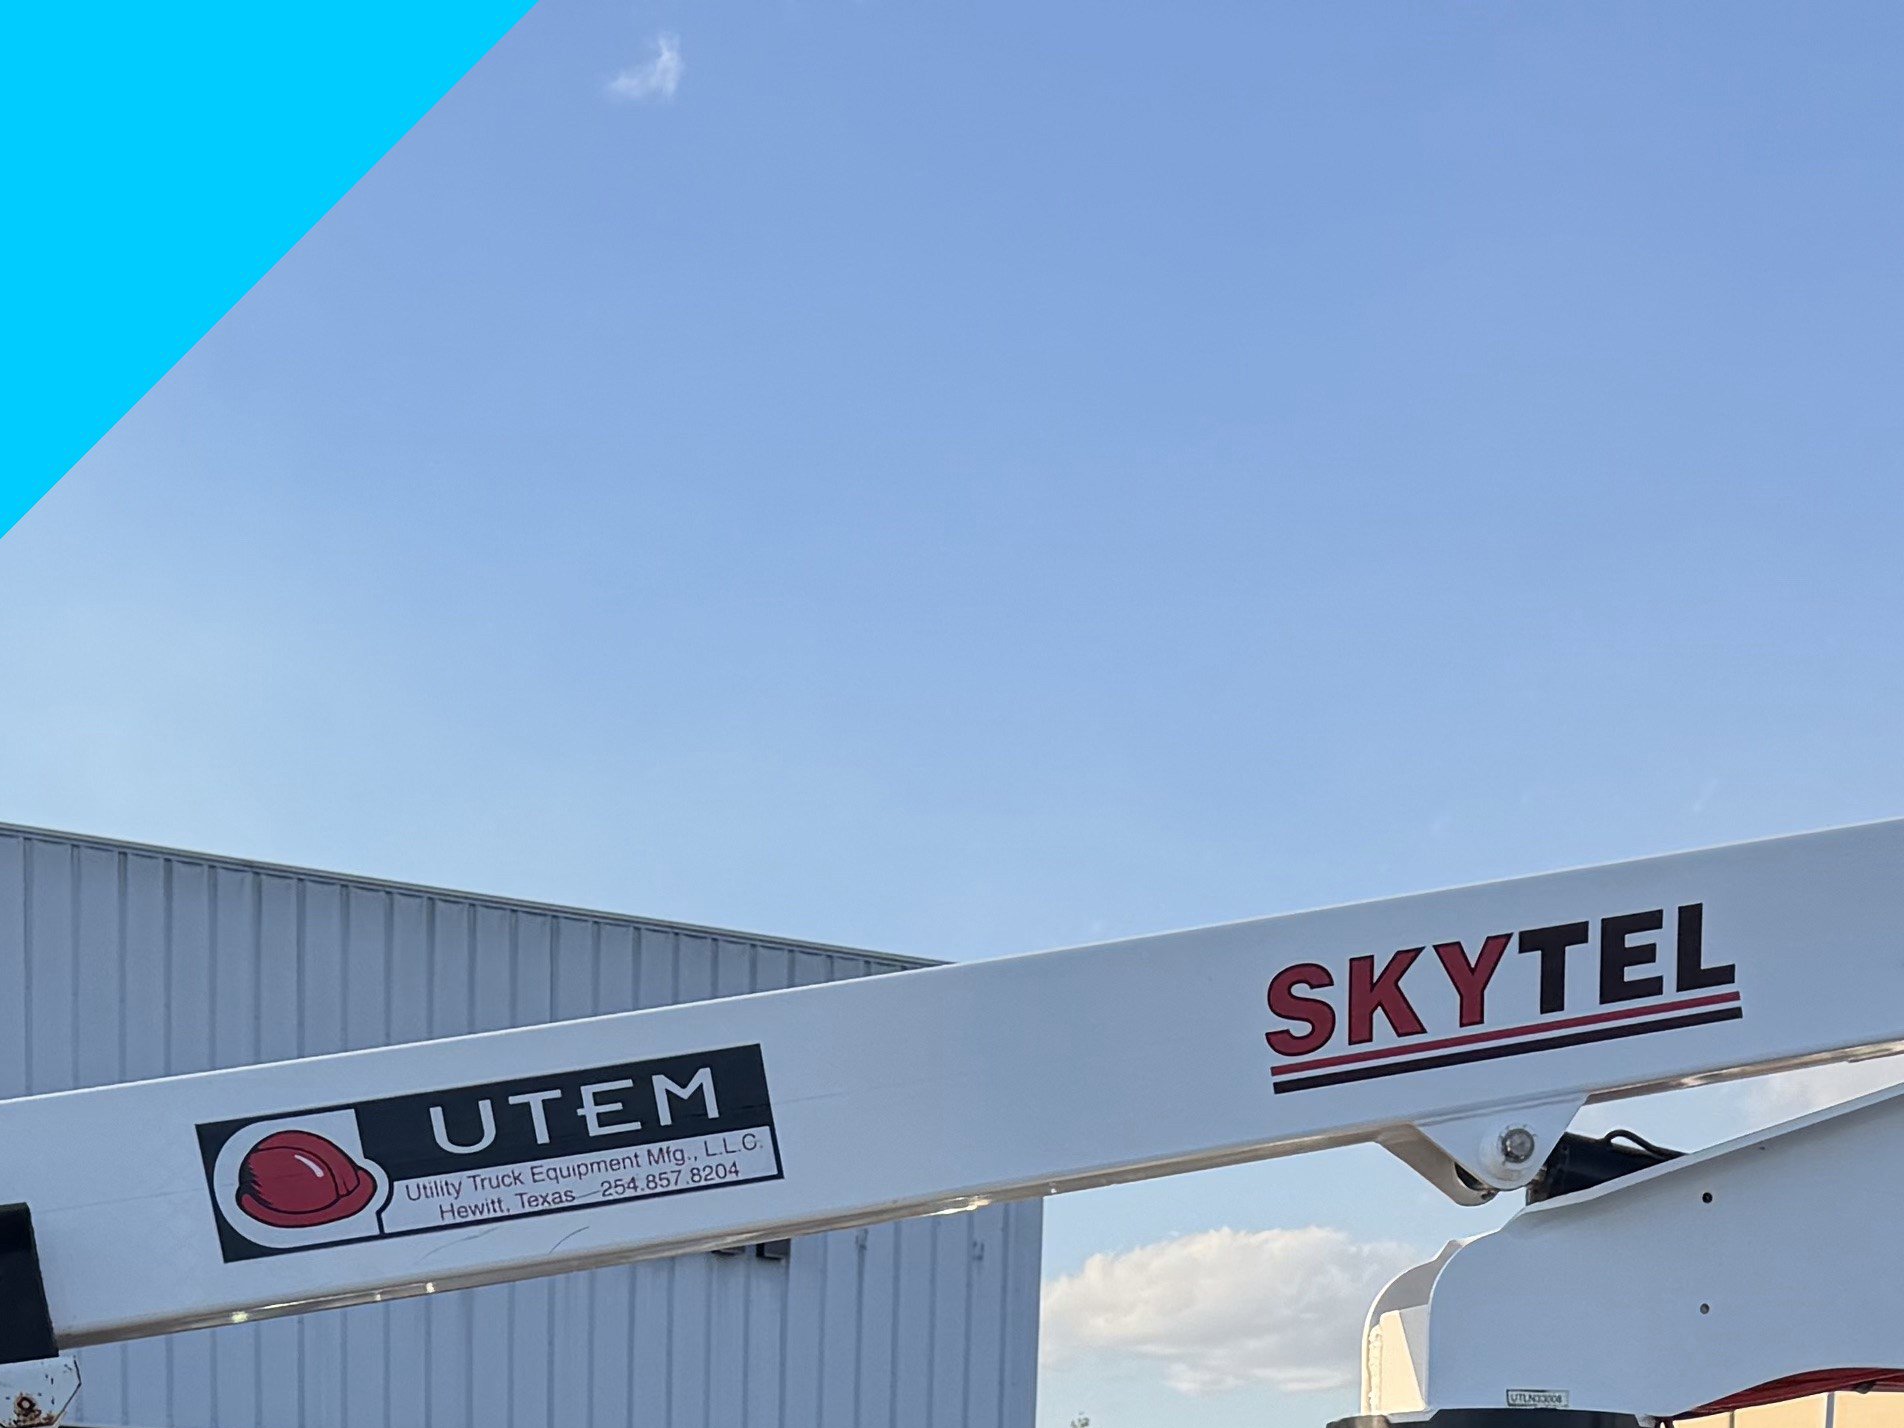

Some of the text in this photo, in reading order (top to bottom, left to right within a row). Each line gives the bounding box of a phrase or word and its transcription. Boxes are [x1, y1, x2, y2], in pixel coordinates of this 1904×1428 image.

[1264, 901, 1736, 1057] SKYTEL
[429, 1067, 720, 1154] UTEM
[405, 1179, 463, 1202] Utility
[467, 1171, 524, 1193] Truck
[531, 1153, 641, 1184] Equipment
[647, 1143, 698, 1167] Mfg.,
[439, 1161, 740, 1221] Hewitt, Texas 254.857.8204
